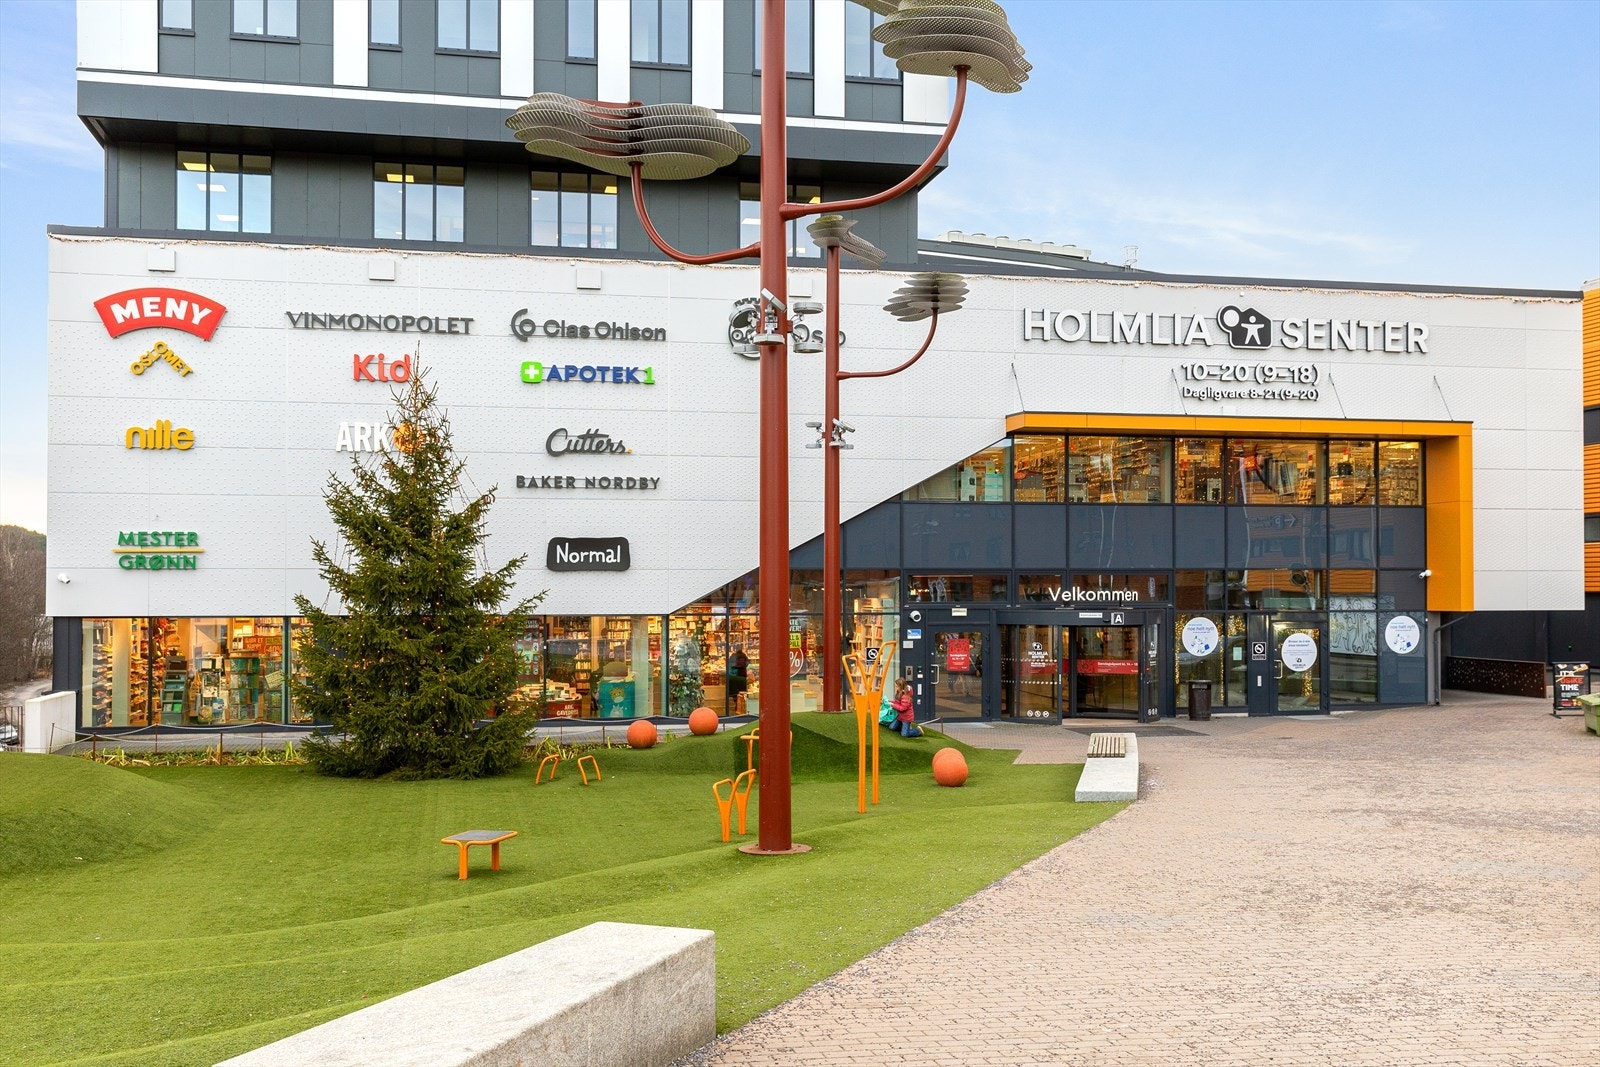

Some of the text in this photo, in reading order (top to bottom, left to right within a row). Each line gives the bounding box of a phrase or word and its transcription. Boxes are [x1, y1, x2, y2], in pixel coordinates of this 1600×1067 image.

[110, 296, 212, 326] MENY
[286, 311, 475, 335] VINMONOPOLET
[543, 319, 667, 341] Clas Ohlson
[1024, 308, 1429, 354] HOLMLIA SENTER
[130, 341, 193, 377] OSLOMET
[353, 353, 411, 383] Kid
[1183, 387, 1247, 401] Dagligvare
[125, 419, 195, 451] nille
[336, 421, 391, 453] ARK
[516, 475, 661, 490] BAKER NORDBY
[117, 531, 199, 546] MESTER
[118, 554, 197, 571] GRØNN
[556, 542, 621, 563] Normal
[1049, 586, 1139, 602] Velkommen
[1114, 614, 1123, 624] A
